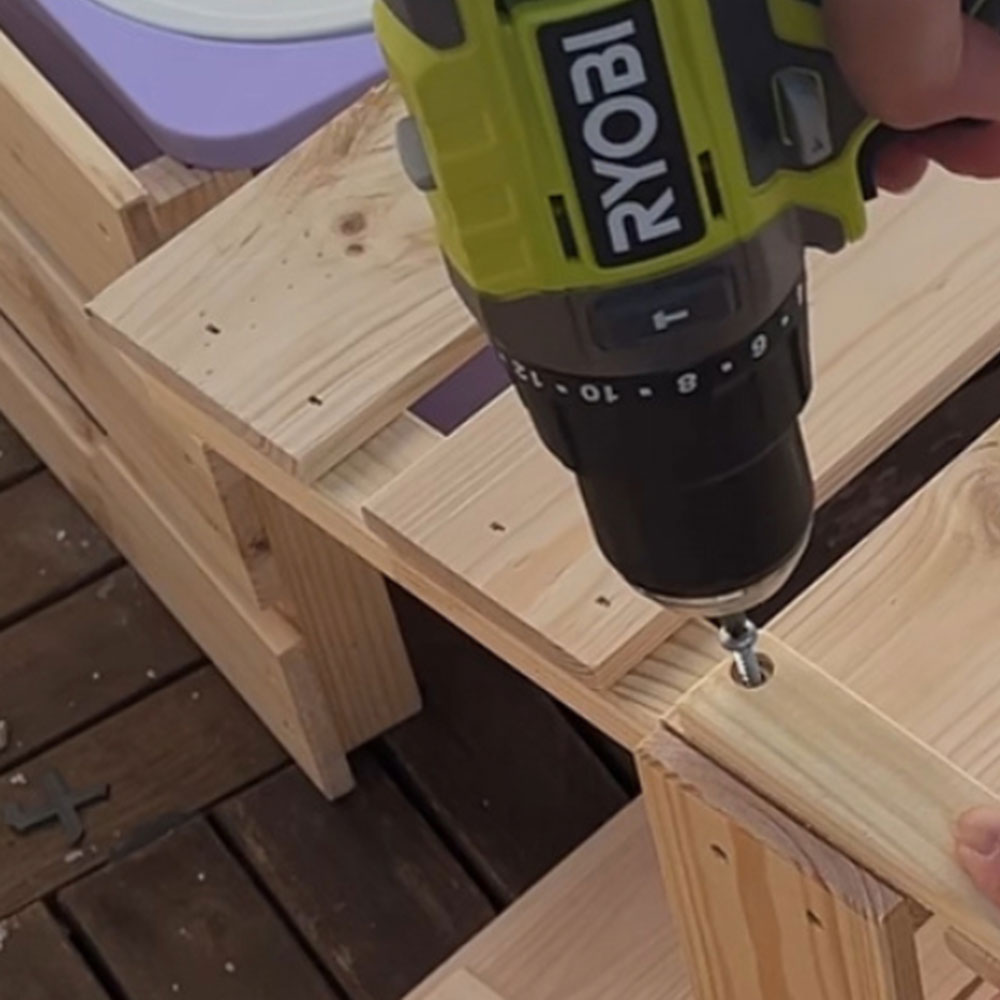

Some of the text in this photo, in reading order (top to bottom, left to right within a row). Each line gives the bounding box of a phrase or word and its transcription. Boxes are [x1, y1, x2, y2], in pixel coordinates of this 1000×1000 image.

[561, 18, 683, 255] RYOBI
[580, 383, 619, 403] 10
[677, 372, 699, 394] 8
